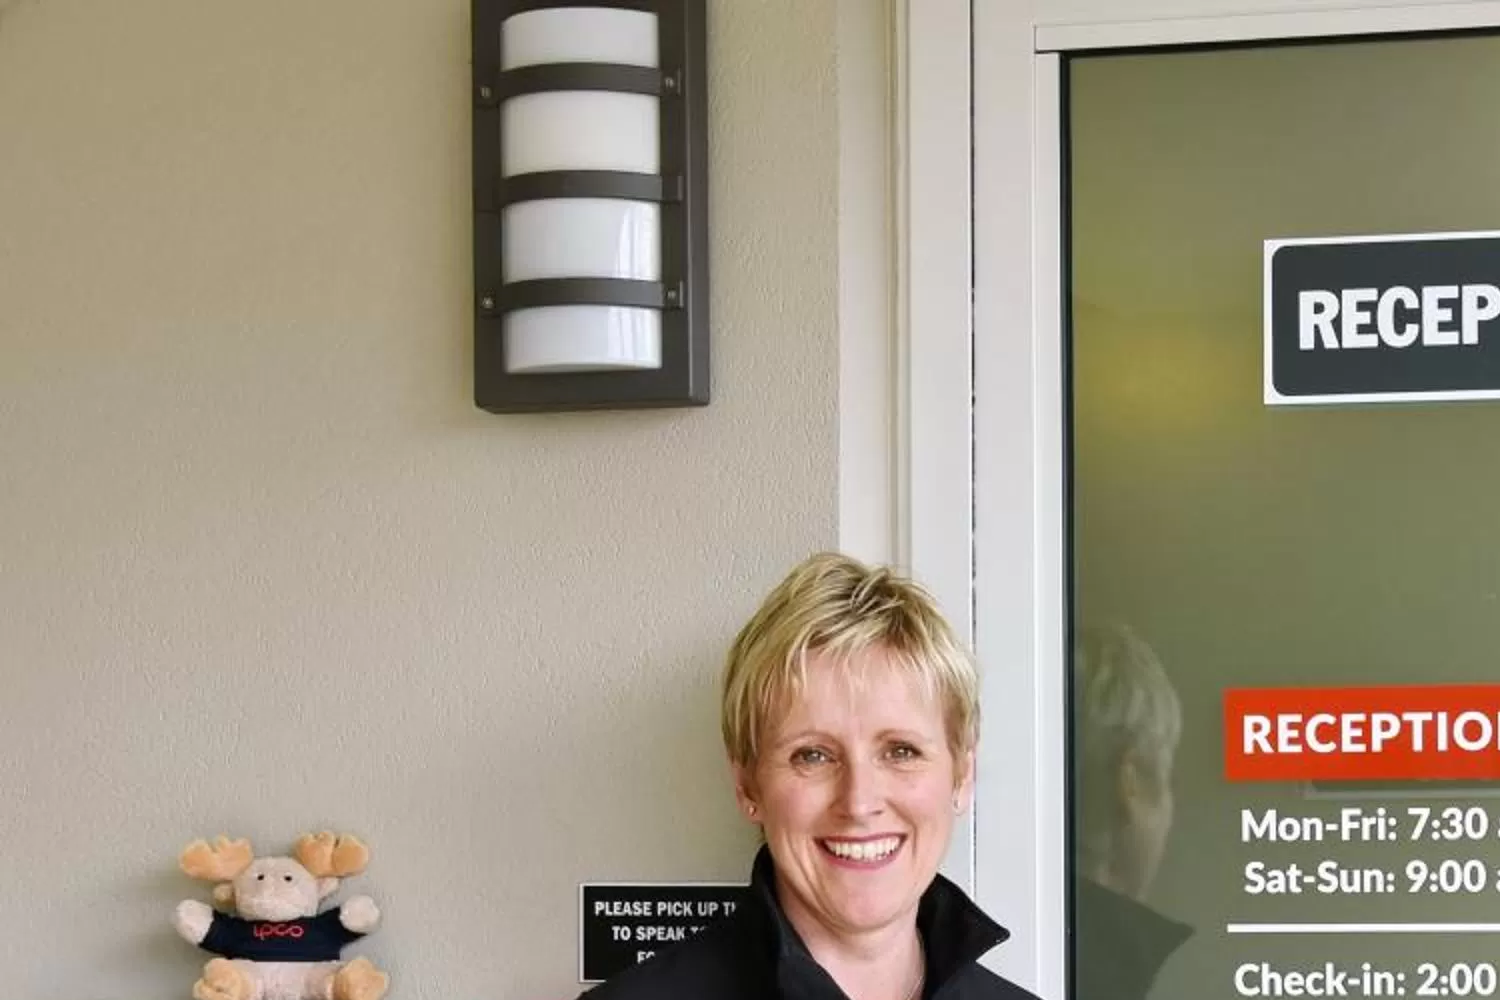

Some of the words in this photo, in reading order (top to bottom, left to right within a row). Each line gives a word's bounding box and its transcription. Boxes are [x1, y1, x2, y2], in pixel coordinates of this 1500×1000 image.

[1241, 807, 1398, 842] Mon-Fri:
[1407, 806, 1489, 841] 7:30
[1244, 860, 1395, 894] Sat-Sun:
[1405, 859, 1487, 893] 9:00
[594, 900, 653, 917] PLEASE
[656, 901, 693, 917] PICK
[697, 901, 719, 917] UP
[611, 925, 632, 941] TO
[635, 925, 685, 942] SPEAK
[1234, 962, 1406, 997] Check-in:
[1416, 962, 1497, 996] 2:00
